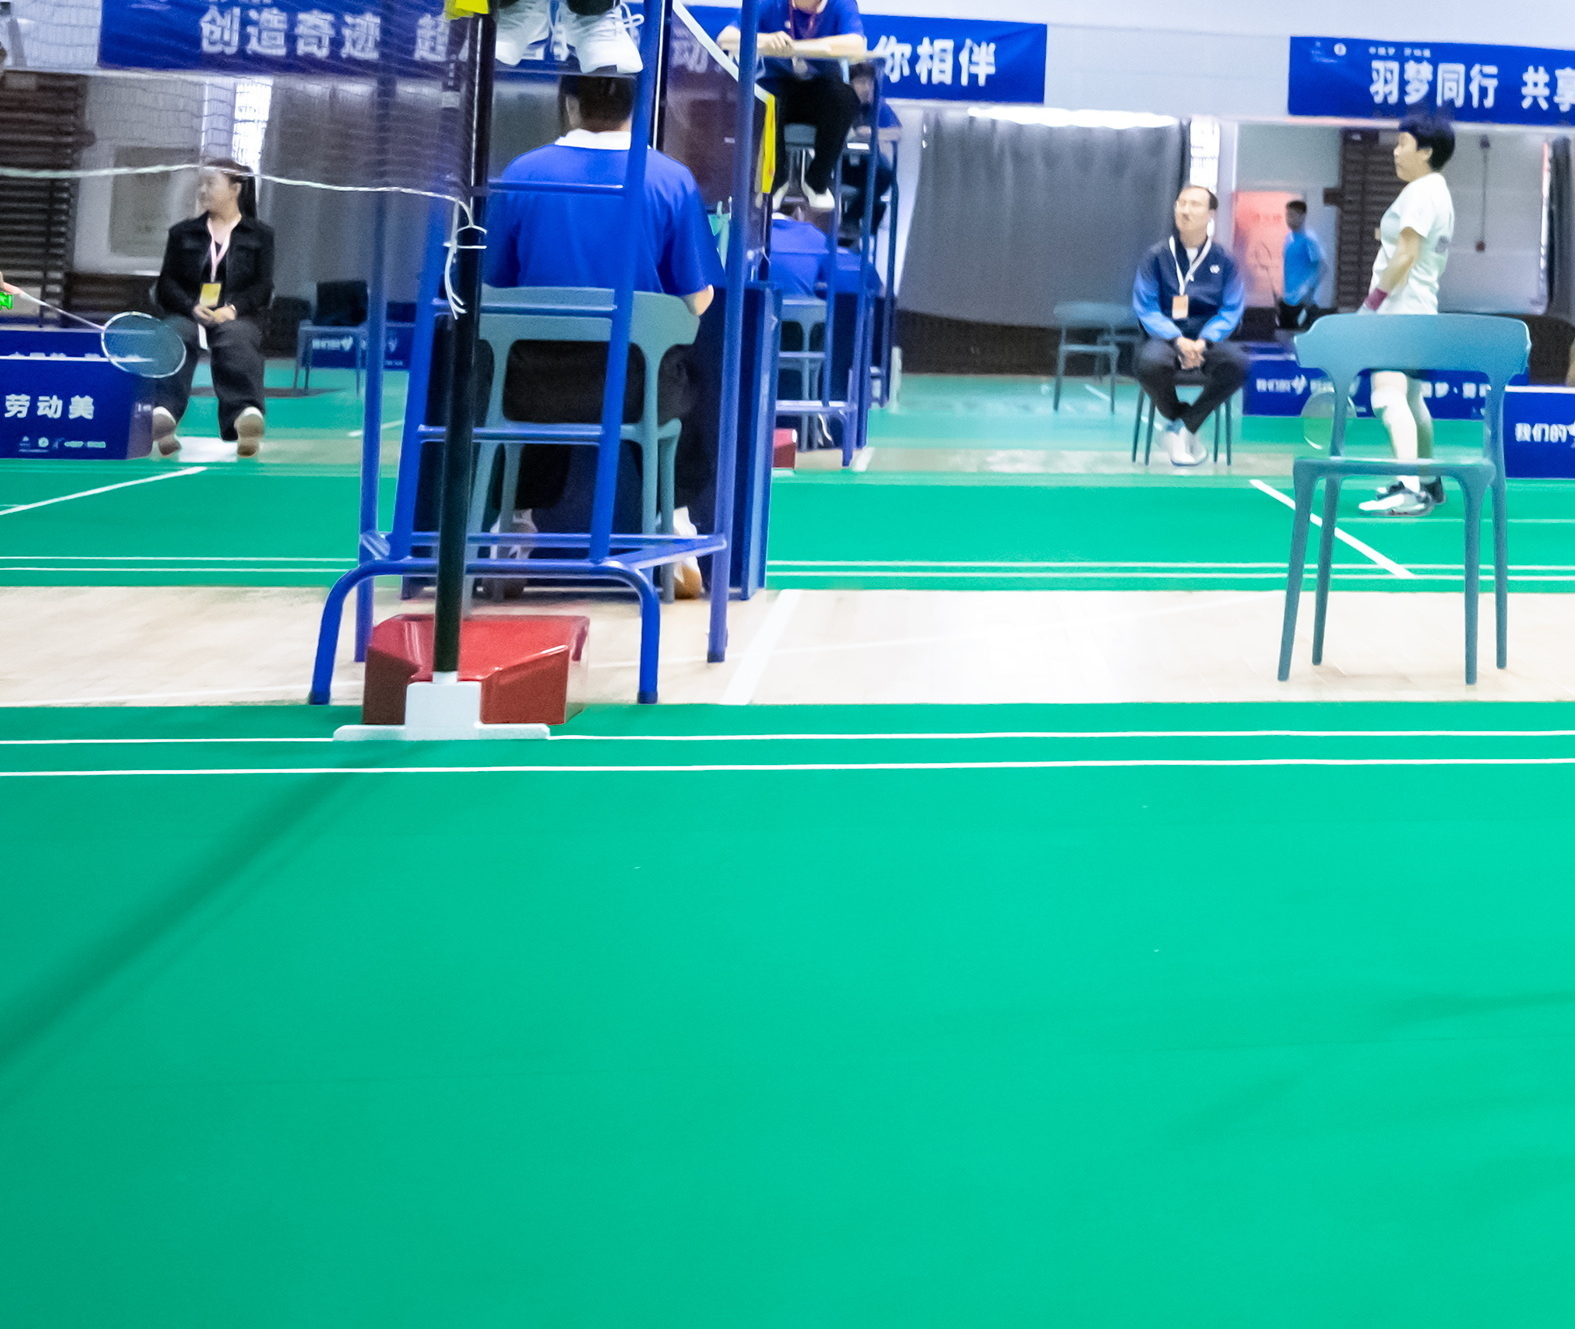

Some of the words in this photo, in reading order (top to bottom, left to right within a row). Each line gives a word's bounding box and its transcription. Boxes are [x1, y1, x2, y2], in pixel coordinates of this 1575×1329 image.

[200, 4, 382, 60] 创造奇迹
[1369, 59, 1499, 109] 羽梦同行
[4, 393, 96, 420] 劳动美
